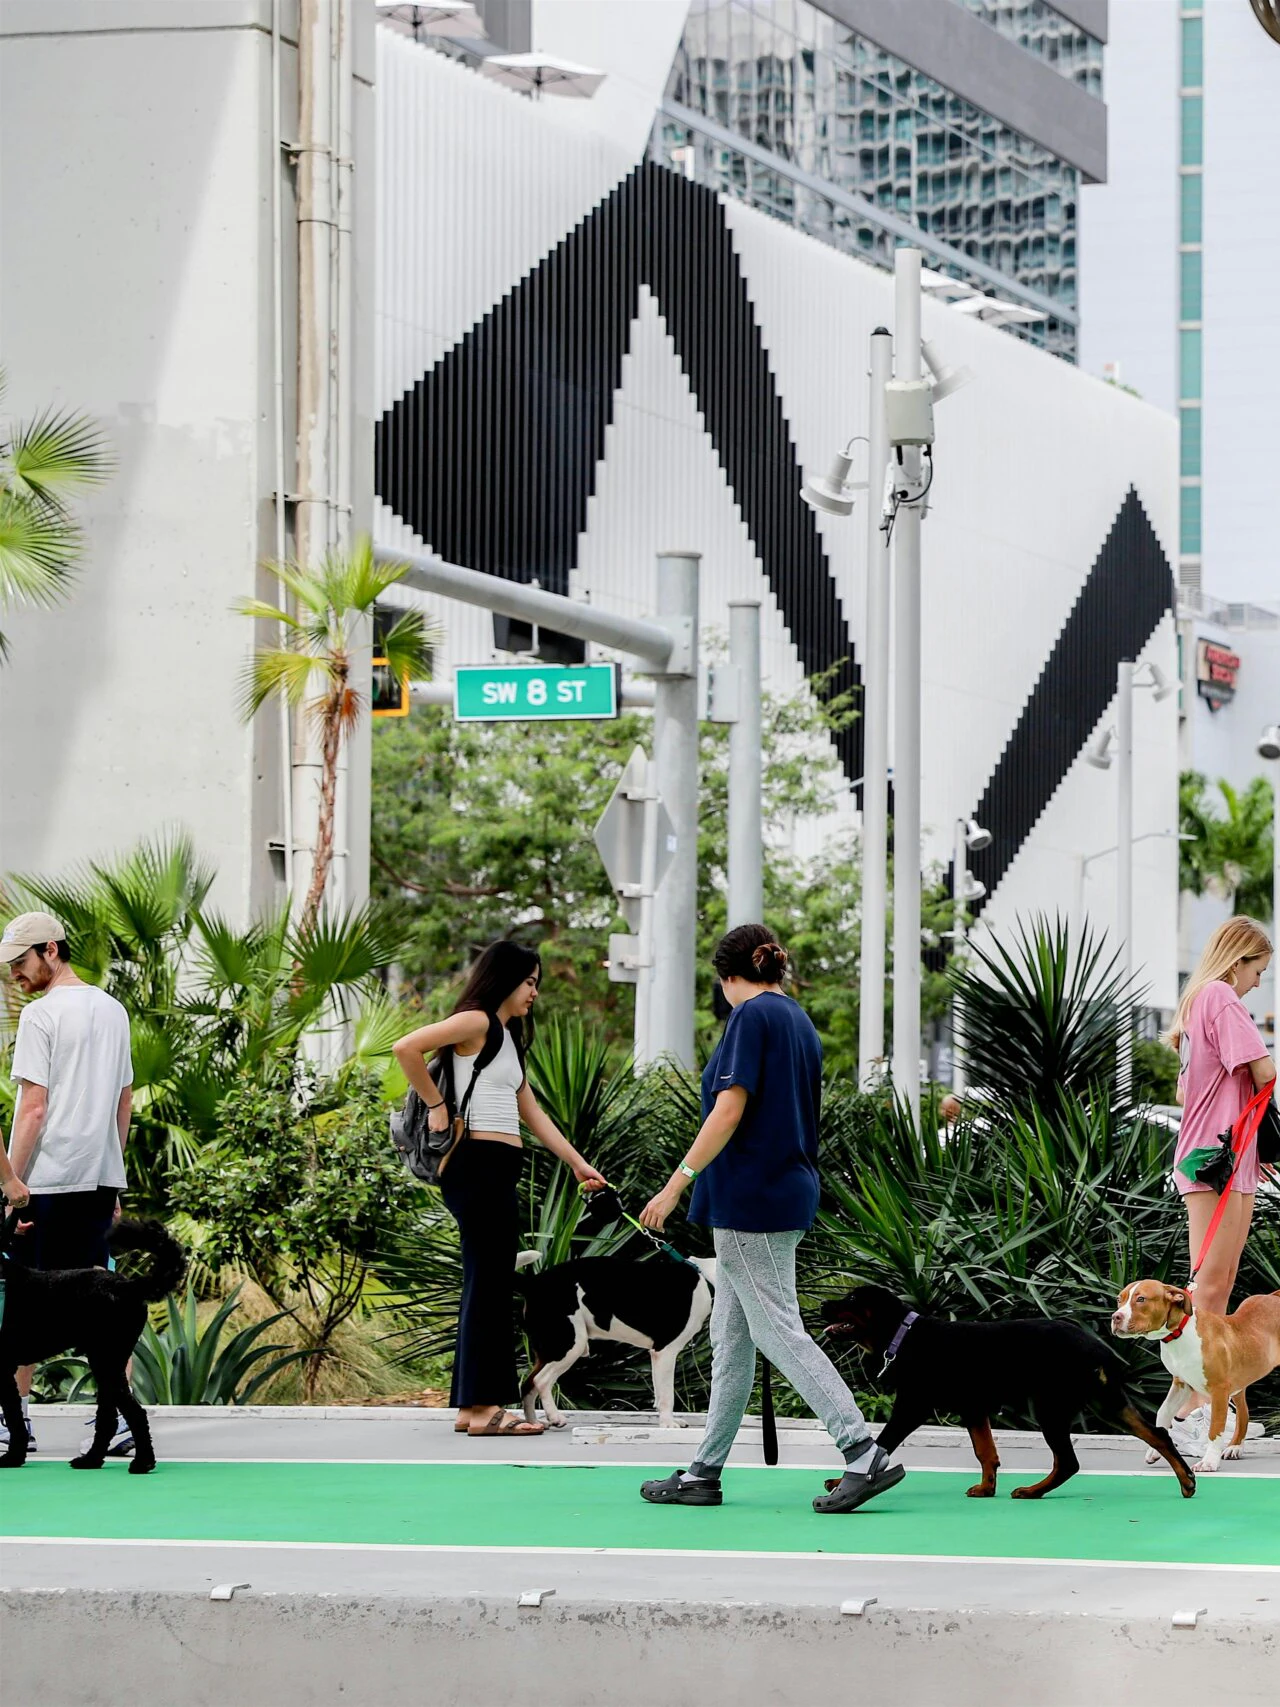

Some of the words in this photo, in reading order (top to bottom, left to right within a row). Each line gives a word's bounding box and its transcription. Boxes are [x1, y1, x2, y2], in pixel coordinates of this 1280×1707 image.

[482, 682, 517, 704] SW
[527, 679, 547, 706] 8
[557, 680, 587, 703] ST
